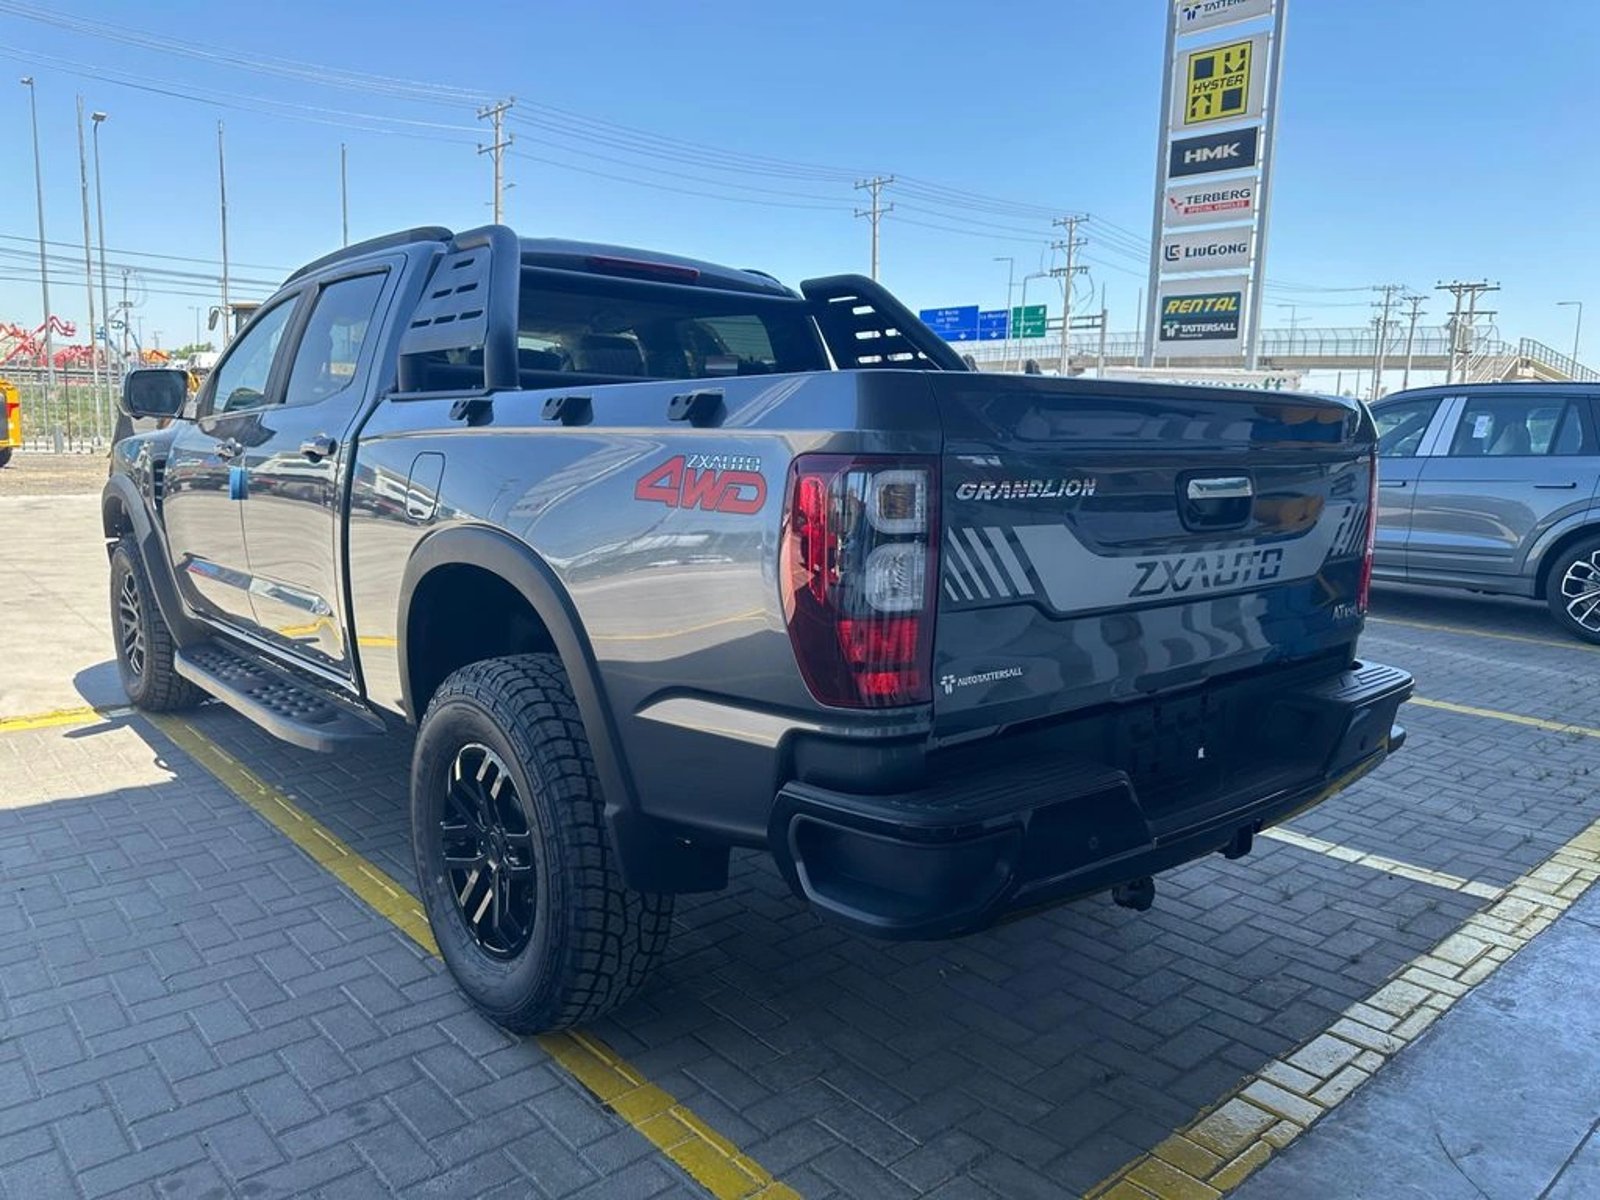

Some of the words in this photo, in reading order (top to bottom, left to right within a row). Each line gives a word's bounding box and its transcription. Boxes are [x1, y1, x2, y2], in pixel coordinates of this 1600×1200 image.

[1192, 74, 1244, 94] HYSTER
[1184, 142, 1240, 164] HMK
[1184, 188, 1251, 205] TERBERG
[1165, 297, 1237, 314] RENTAL
[1181, 322, 1237, 333] TATTERSALL
[686, 454, 761, 471] ZXAUTO
[634, 454, 767, 515] 4WD
[956, 477, 1097, 500] GRANDLION
[1128, 548, 1284, 598] ZXAUTO
[957, 667, 1023, 687] AUTOTATTERSALL
